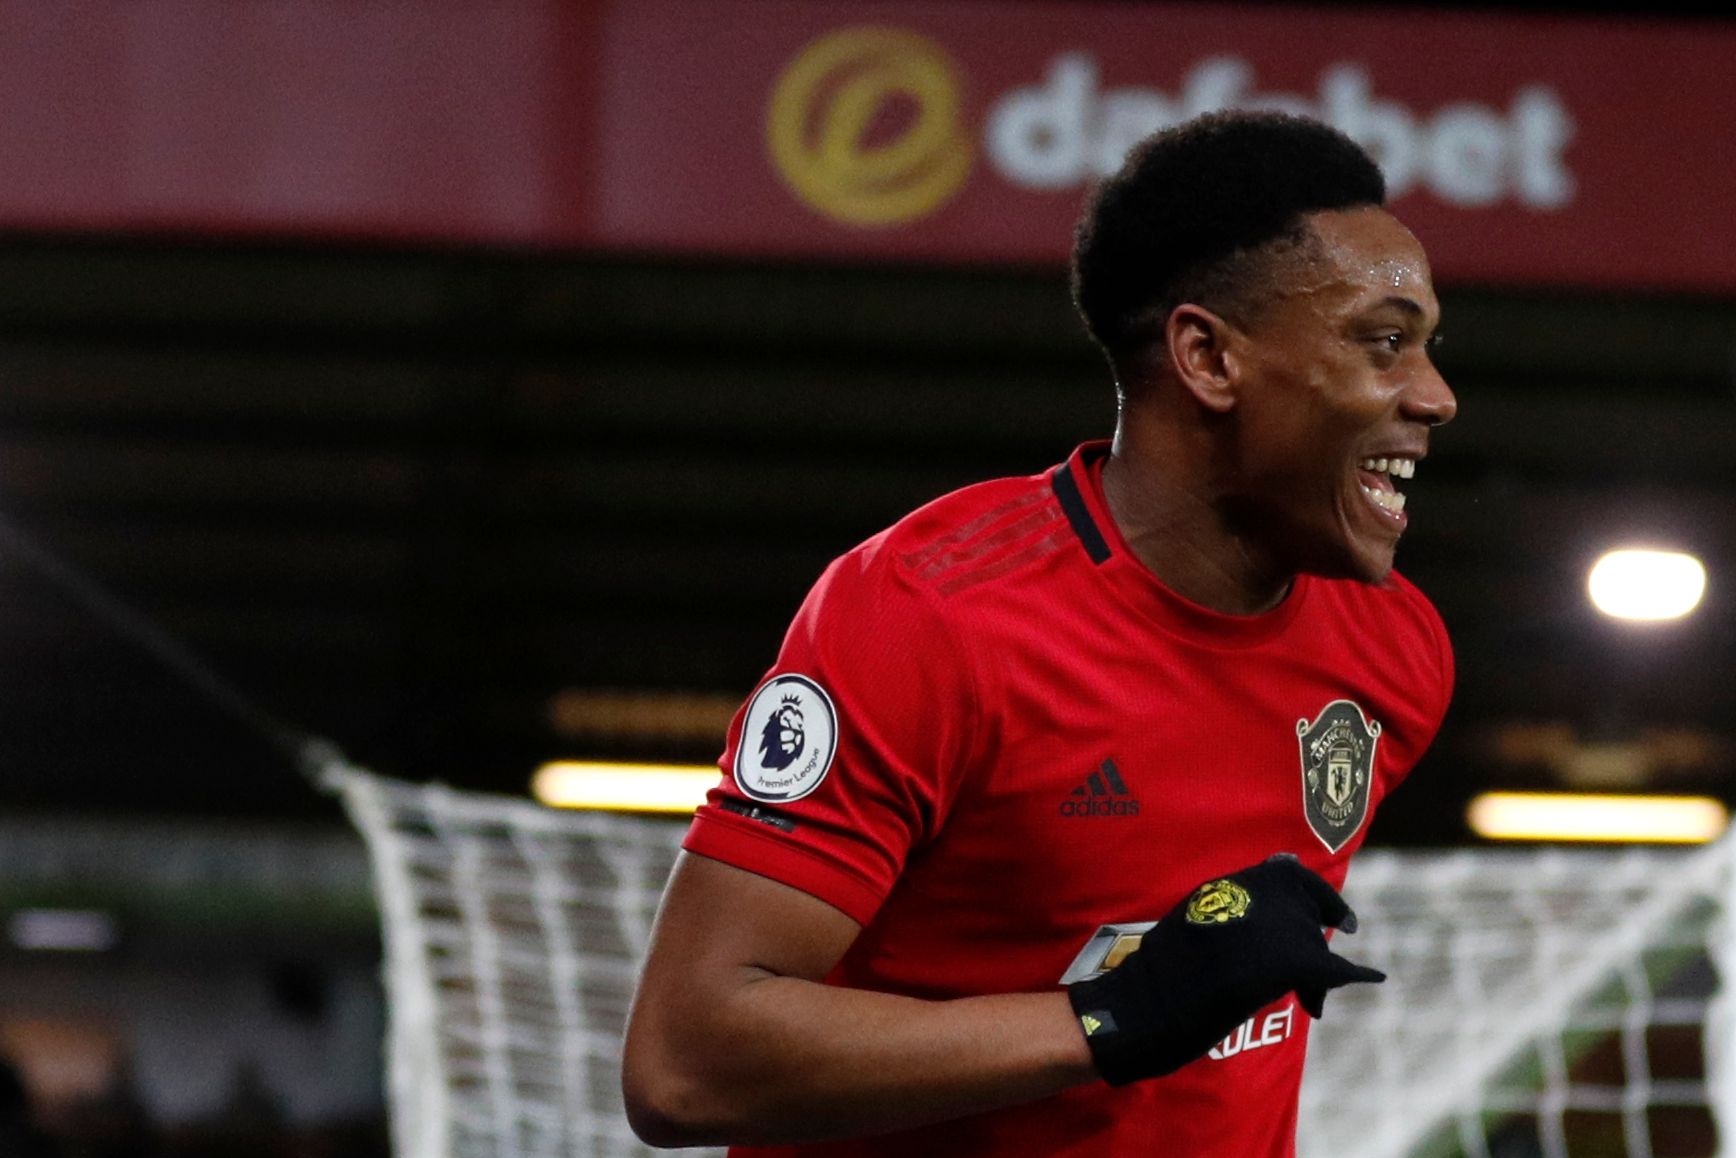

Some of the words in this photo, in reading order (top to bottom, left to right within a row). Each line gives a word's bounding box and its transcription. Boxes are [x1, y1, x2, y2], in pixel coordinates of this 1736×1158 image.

[758, 776, 793, 788] Premier
[793, 747, 819, 782] League
[1060, 795, 1139, 816] adidas
